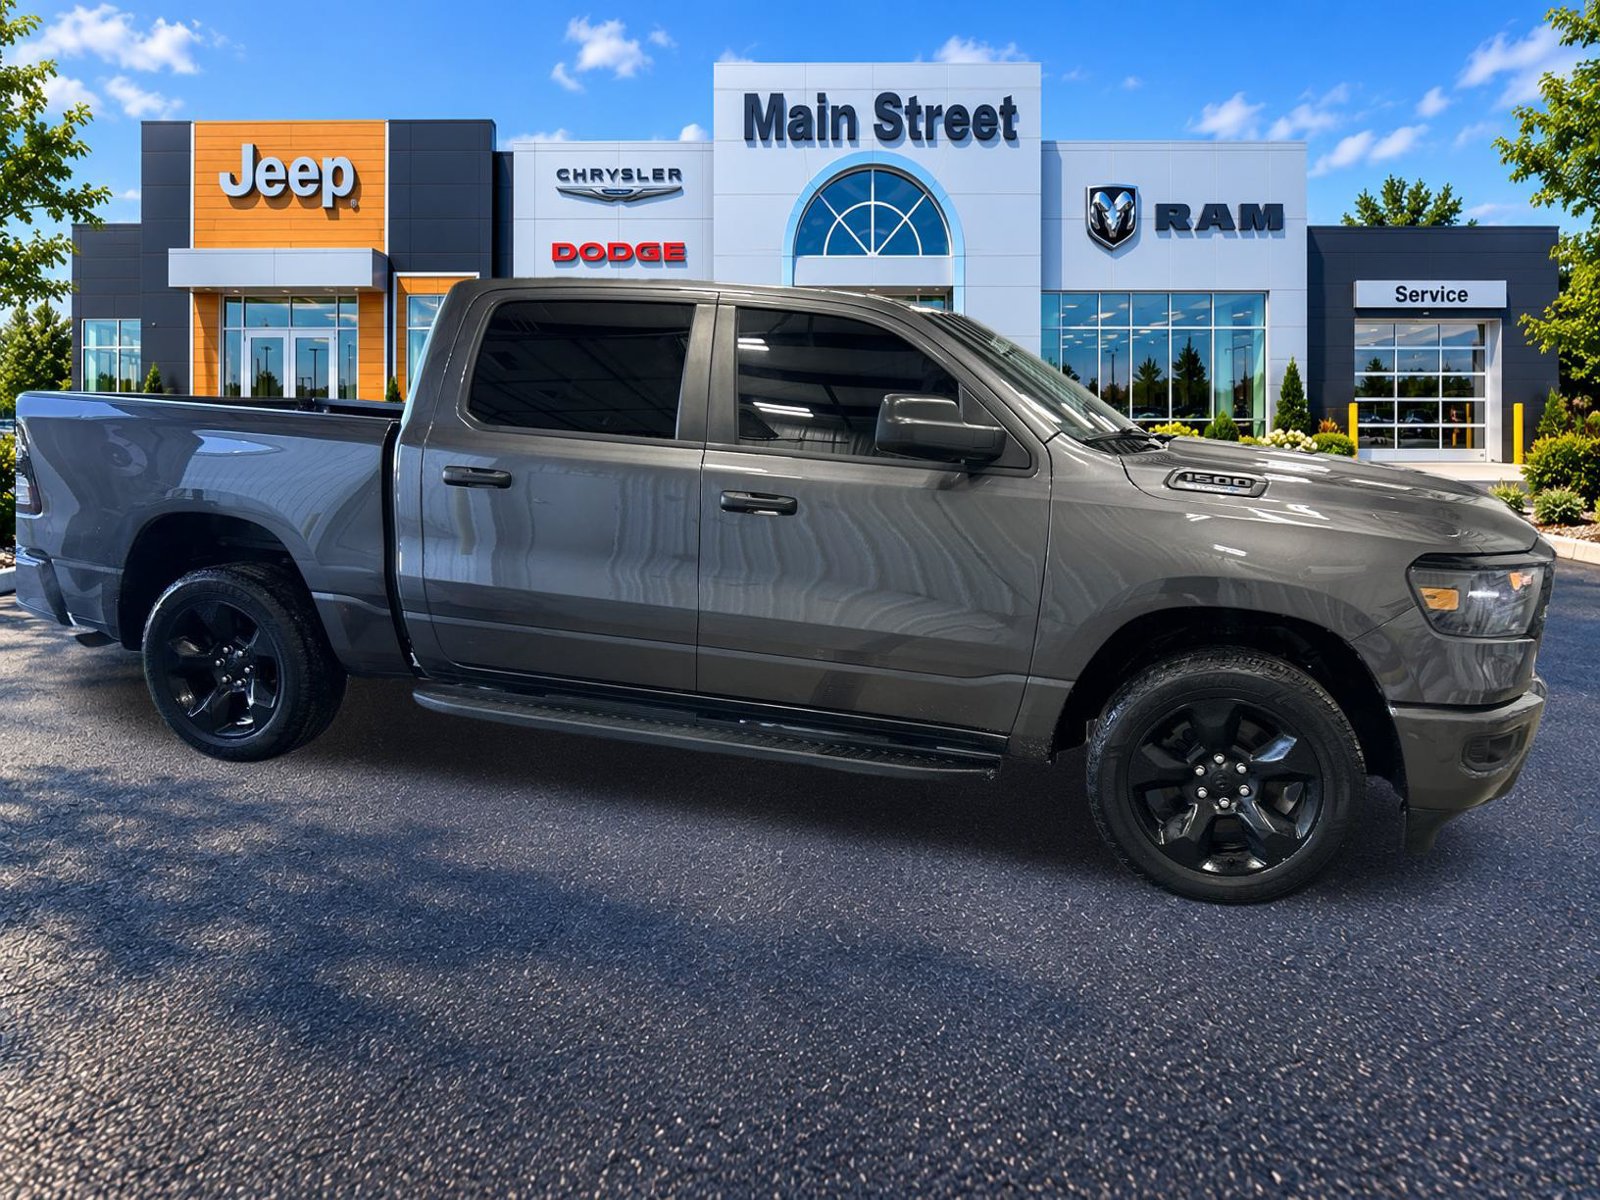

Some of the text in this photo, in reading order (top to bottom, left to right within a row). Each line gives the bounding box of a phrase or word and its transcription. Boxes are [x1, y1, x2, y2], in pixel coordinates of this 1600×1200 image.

[744, 91, 1018, 142] Main Street
[218, 143, 355, 208] Jeep
[556, 168, 683, 183] CHRYSLER
[1155, 203, 1284, 232] RAM
[551, 241, 687, 263] DODGE
[1395, 285, 1469, 304] Service
[1184, 473, 1252, 488] 1500
